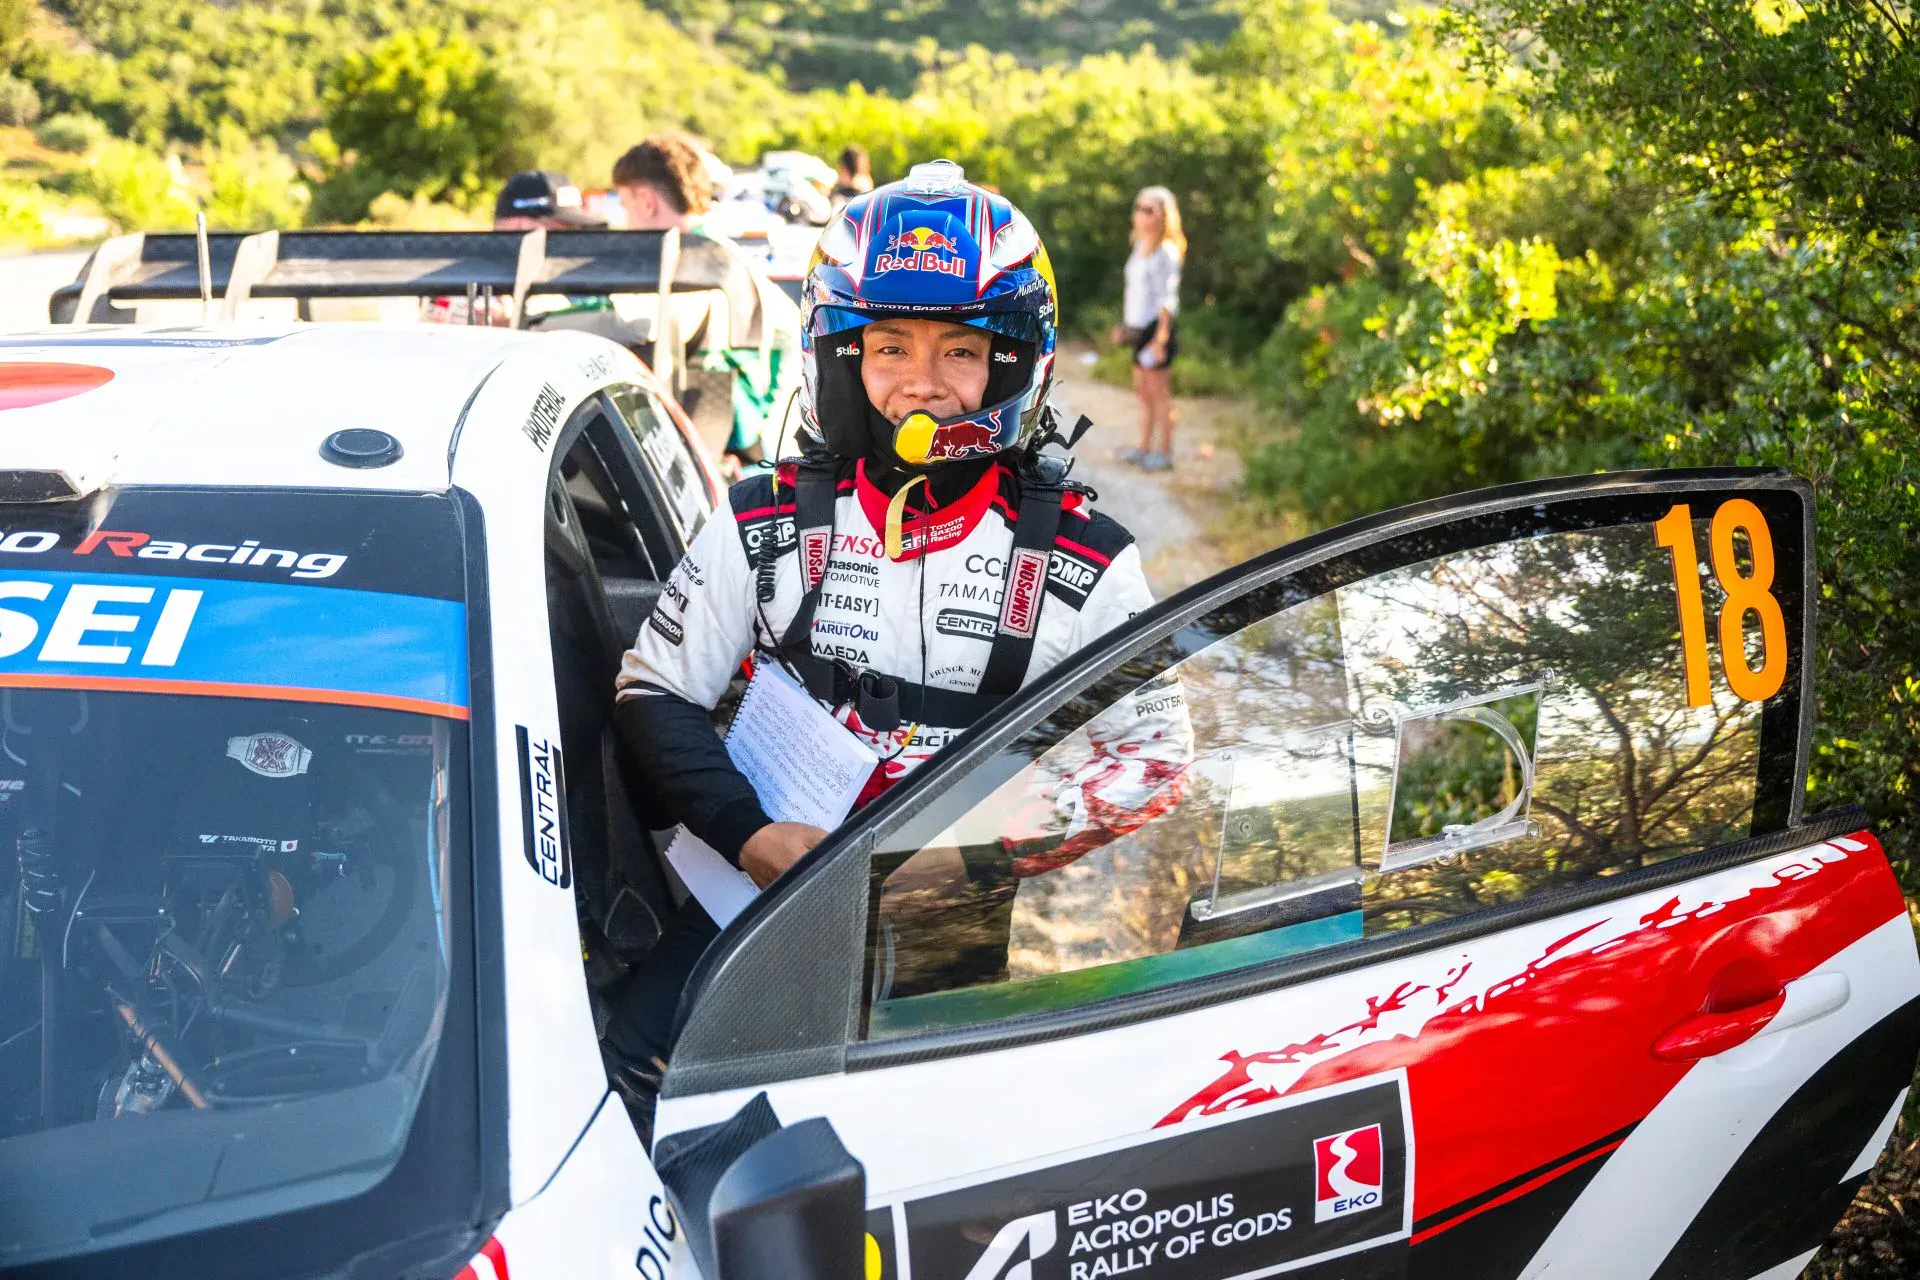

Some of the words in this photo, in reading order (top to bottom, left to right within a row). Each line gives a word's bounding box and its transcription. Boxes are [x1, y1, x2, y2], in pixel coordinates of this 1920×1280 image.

[875, 251, 921, 273] Red
[921, 252, 966, 278] Bull
[868, 303, 910, 311] TOYOTA
[1038, 298, 1054, 319] Stilo
[836, 344, 860, 357] Stilo
[994, 352, 1017, 363] Stilo
[929, 516, 965, 531] TOYOTA
[930, 523, 963, 537] GAZOO
[930, 530, 962, 543] Racing
[73, 530, 348, 578] Racing
[1049, 555, 1094, 588] OMP
[1010, 560, 1038, 628] SIMPSON
[1653, 498, 1787, 707] 18
[533, 738, 558, 886] CENTRAL
[222, 834, 277, 845] TAKAMOTO
[1068, 1188, 1148, 1226] EKO
[1333, 1192, 1378, 1213] EKO
[1068, 1193, 1235, 1257] ACROPOLIS
[1070, 1241, 1158, 1280] RALLY
[1165, 1230, 1205, 1259] OF
[1211, 1207, 1292, 1247] GODS
